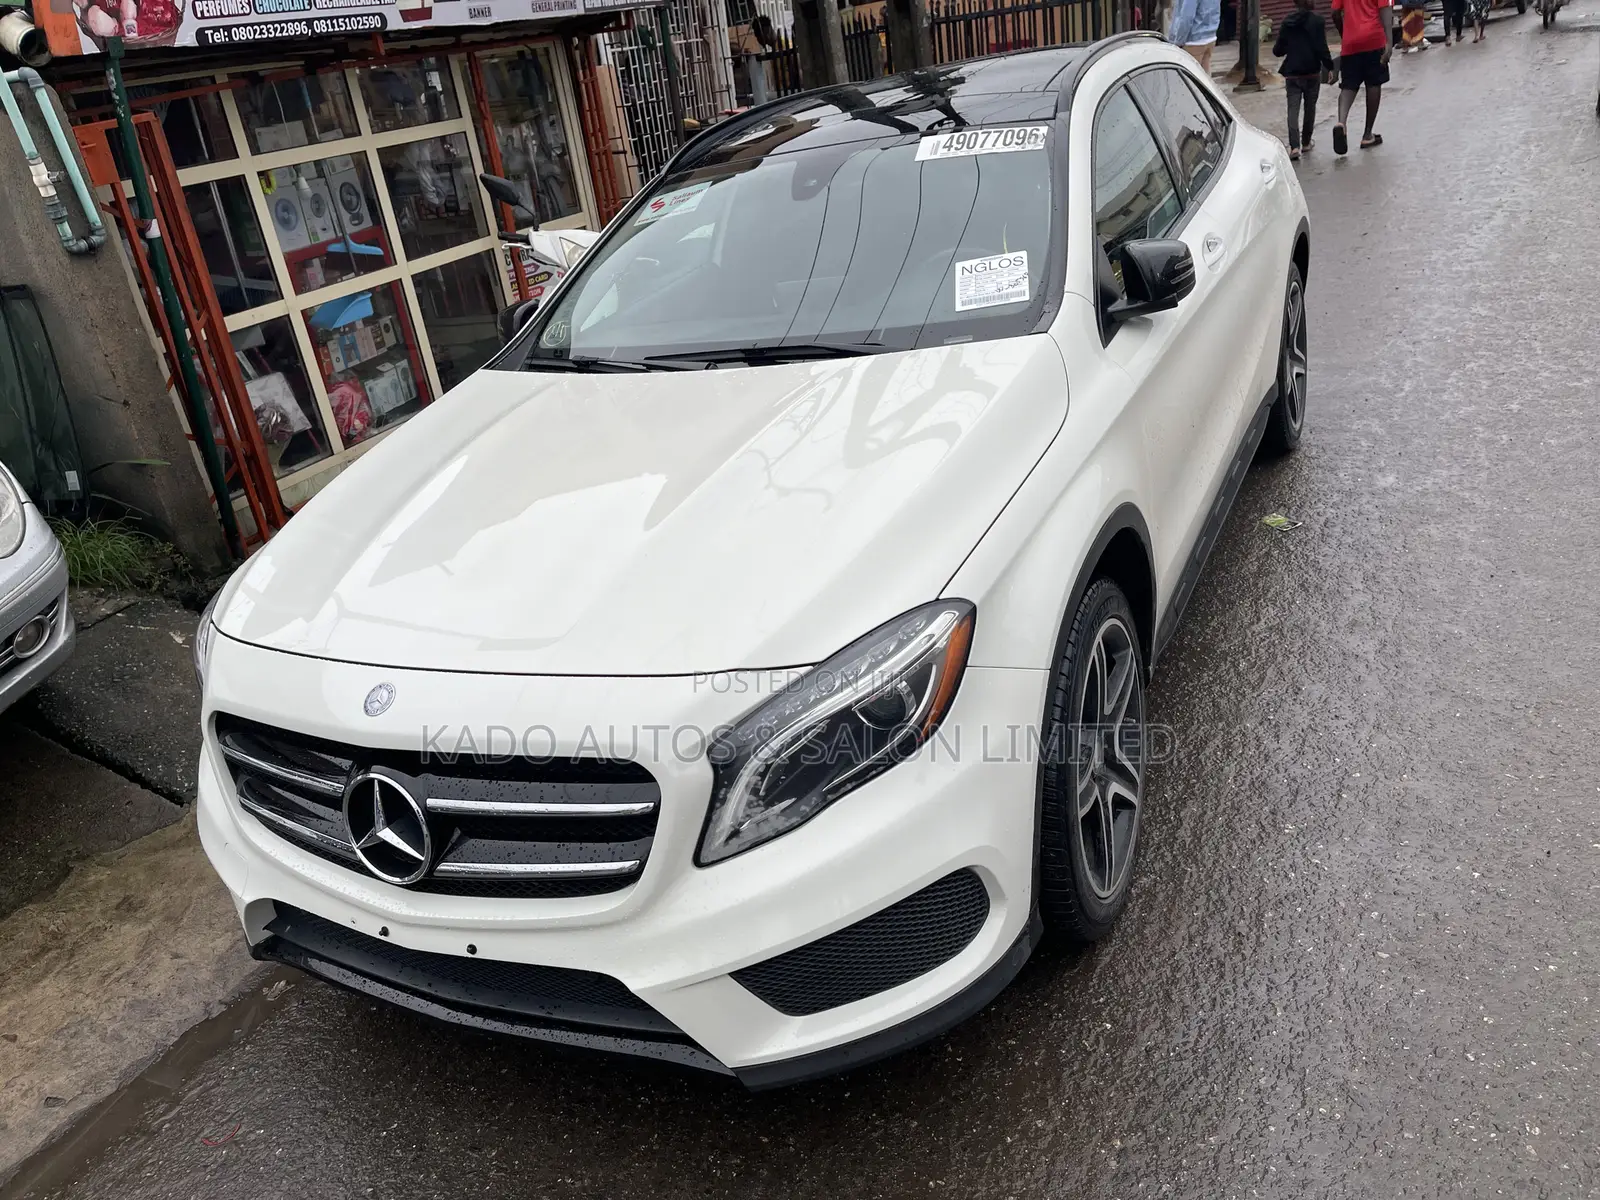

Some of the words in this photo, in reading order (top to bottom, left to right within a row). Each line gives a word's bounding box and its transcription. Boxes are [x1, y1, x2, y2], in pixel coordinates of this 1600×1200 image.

[194, 0, 251, 17] PERFUMES
[255, 0, 311, 13] CHOCOLATE
[468, 6, 492, 19] BANNER
[205, 29, 229, 44] Tel:
[231, 21, 312, 41] 08023322896,
[313, 15, 381, 33] 08115102590
[961, 256, 1024, 276] NGLOS
